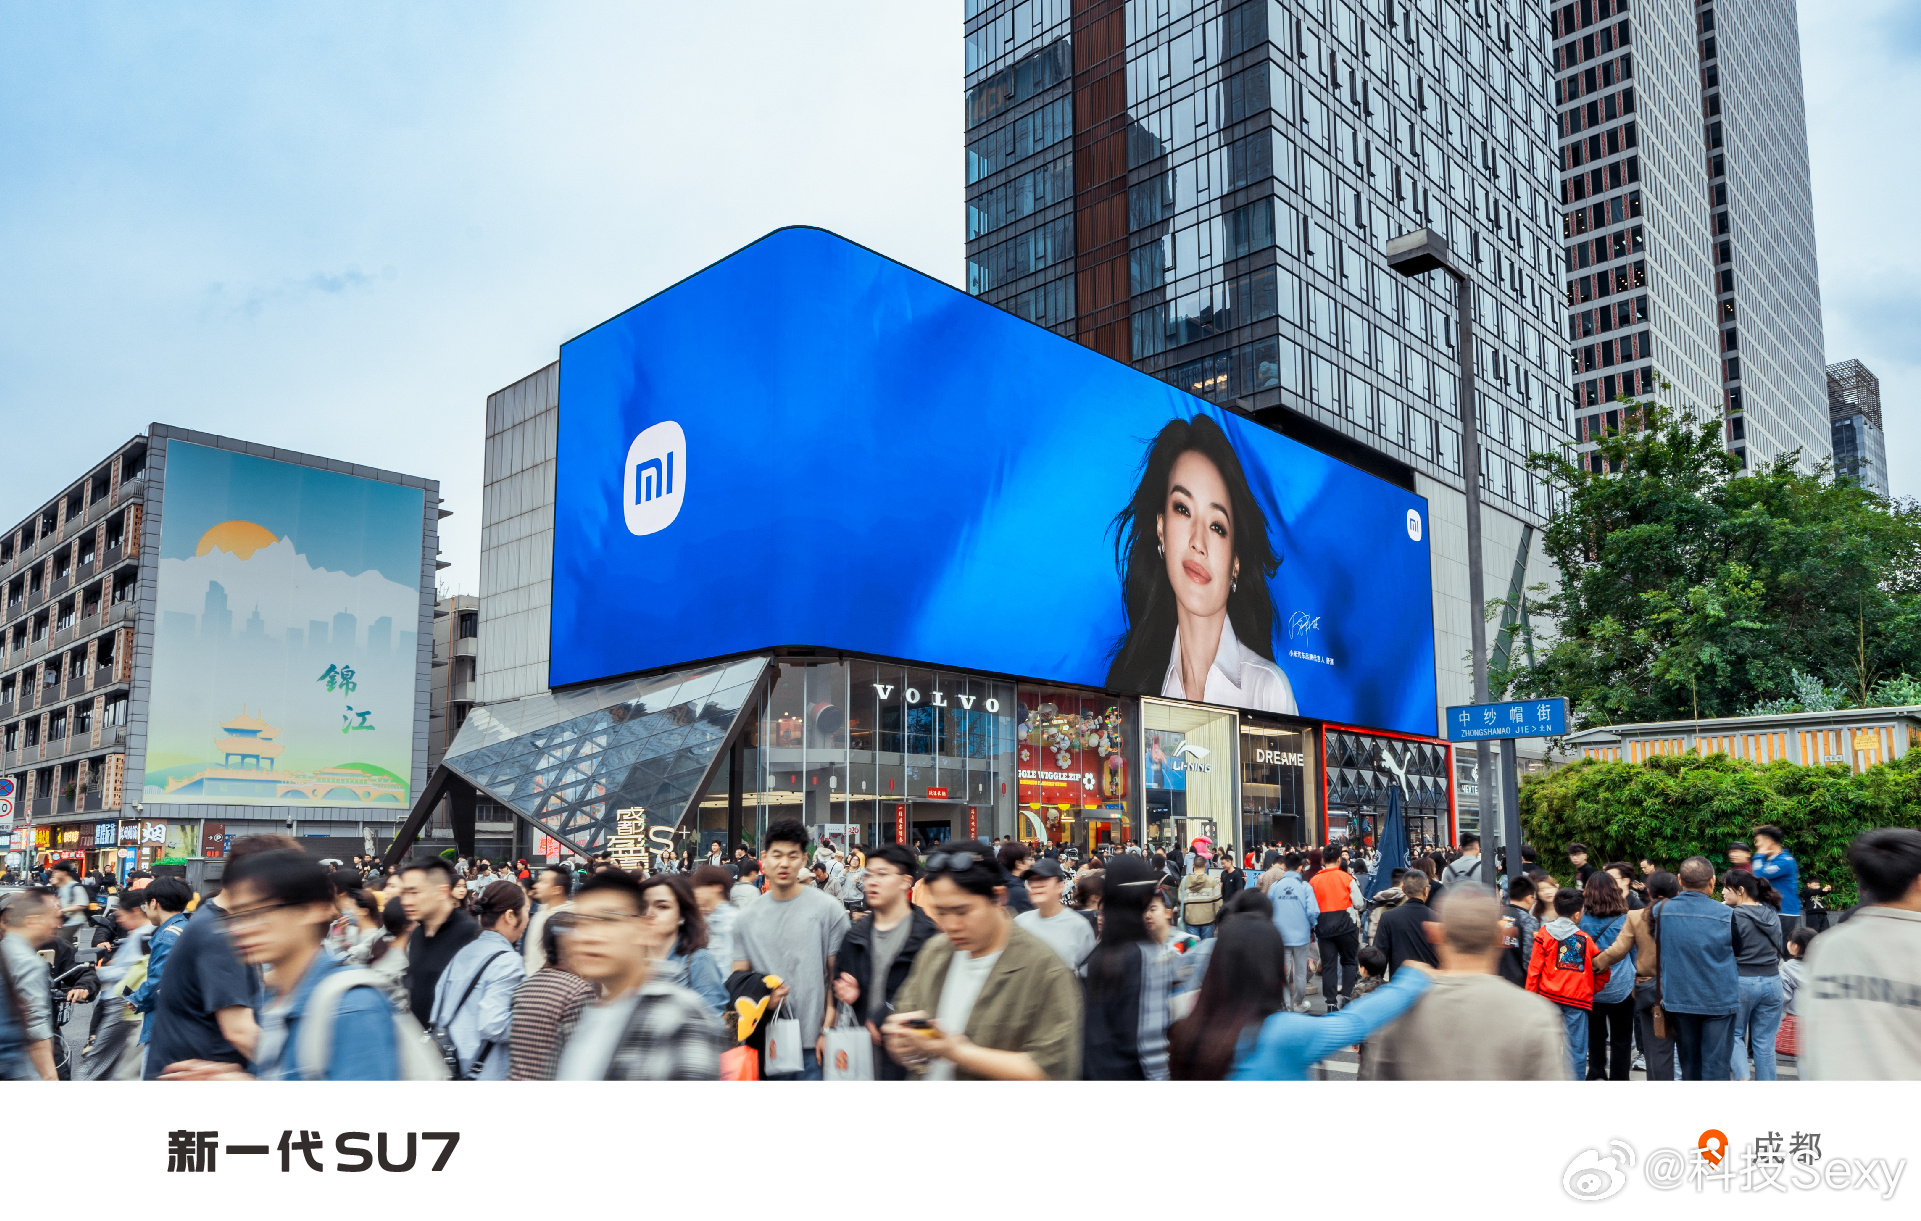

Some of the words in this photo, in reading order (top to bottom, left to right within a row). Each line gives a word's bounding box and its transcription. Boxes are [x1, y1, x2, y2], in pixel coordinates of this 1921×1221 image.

[872, 683, 1000, 713] VOLVO
[1458, 703, 1551, 727] 中纱帽街
[1515, 725, 1530, 734] JIE
[1172, 760, 1212, 773] LI-NING
[1256, 748, 1305, 767] DREAME
[141, 822, 167, 844] 烟
